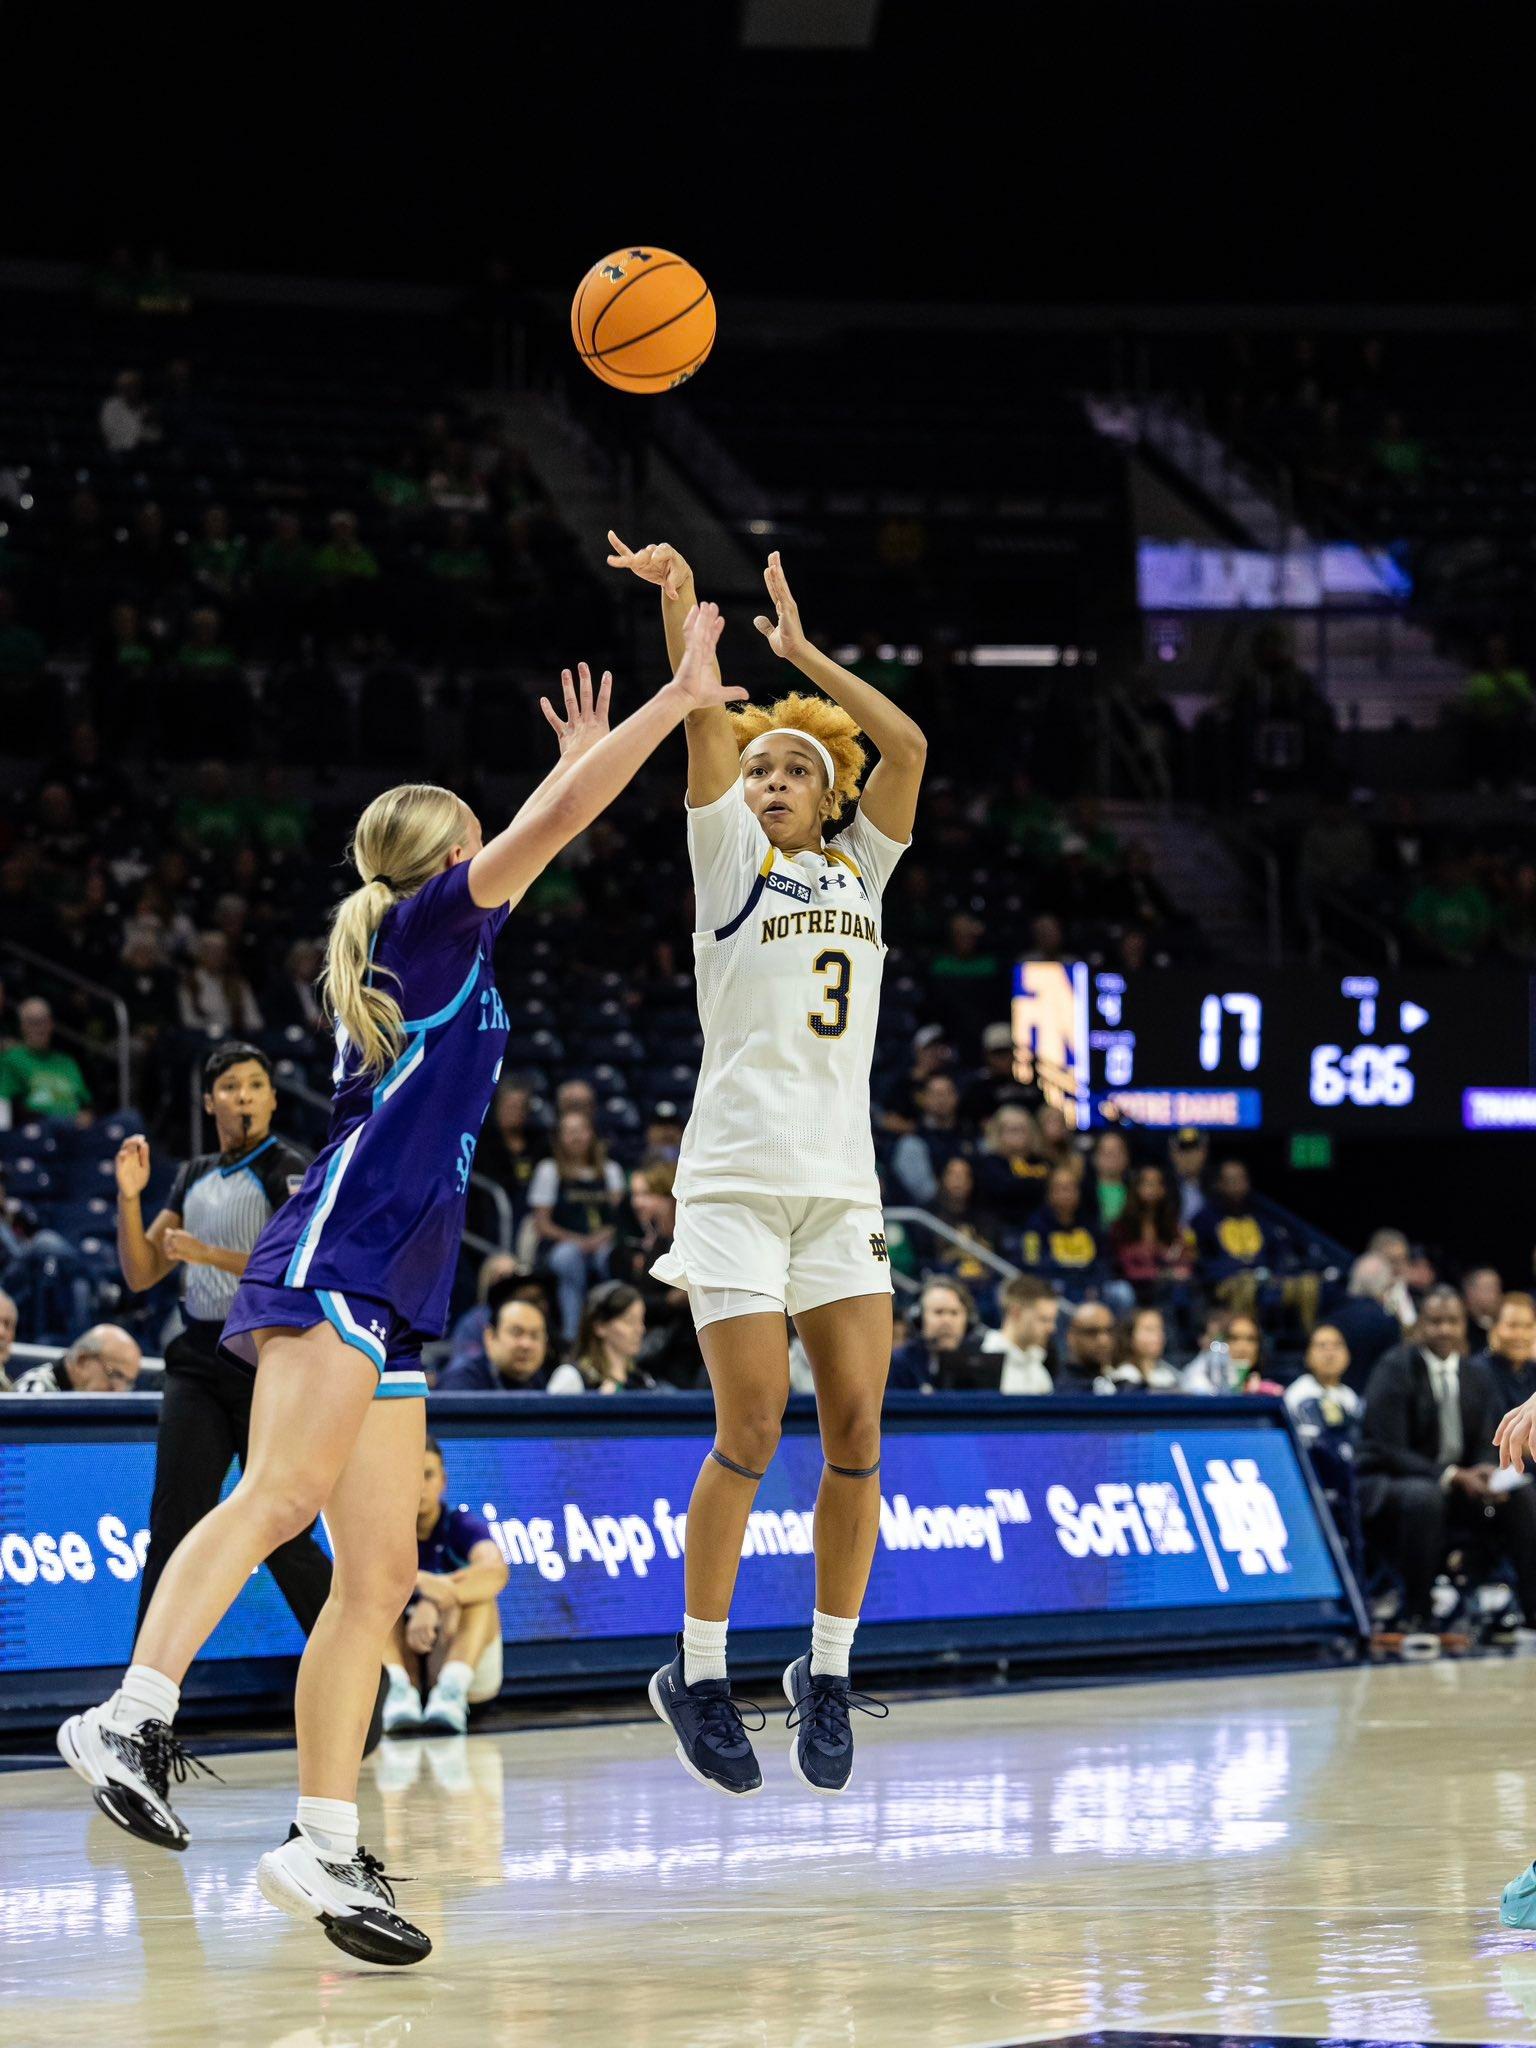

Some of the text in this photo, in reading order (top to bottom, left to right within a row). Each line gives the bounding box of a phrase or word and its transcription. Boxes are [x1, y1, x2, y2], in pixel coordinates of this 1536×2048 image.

[767, 874, 798, 897] SoFi
[761, 909, 880, 952] NOTRE DAM
[807, 948, 855, 1040] 3
[1199, 992, 1263, 1072] 17
[1309, 1043, 1415, 1106] 6:06
[0, 1531, 96, 1585] ose
[563, 1503, 656, 1578] App
